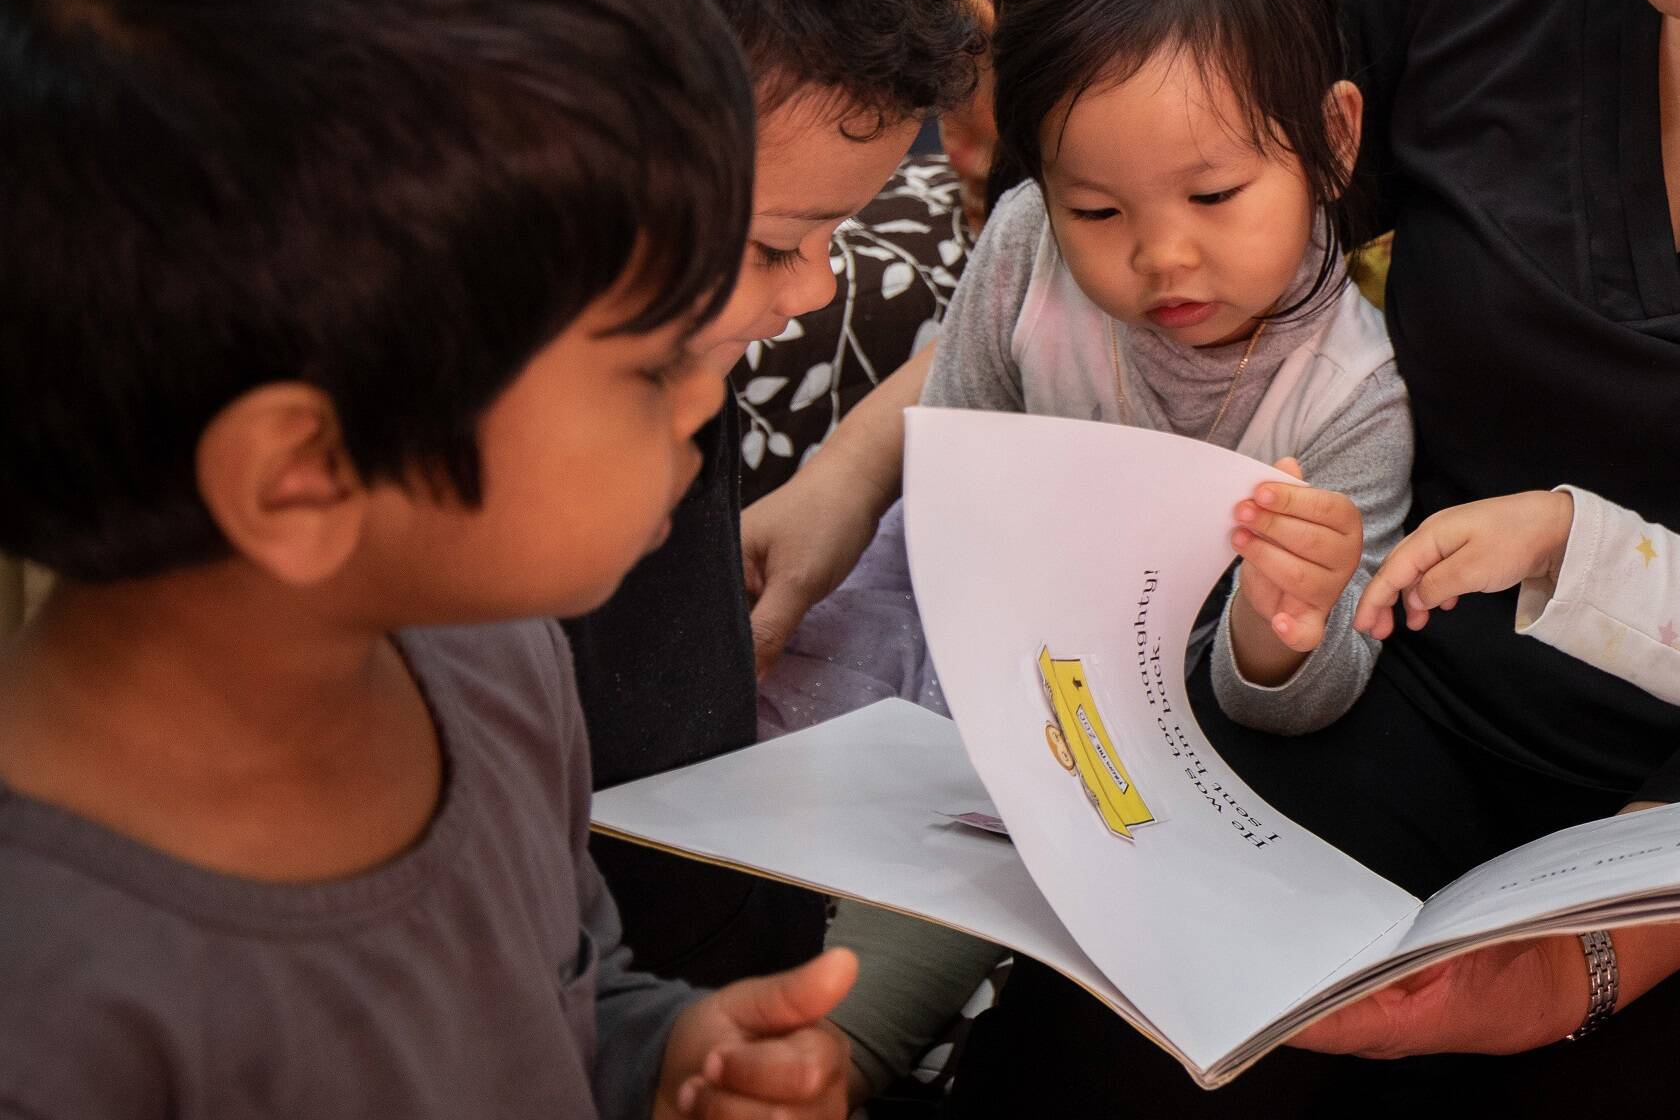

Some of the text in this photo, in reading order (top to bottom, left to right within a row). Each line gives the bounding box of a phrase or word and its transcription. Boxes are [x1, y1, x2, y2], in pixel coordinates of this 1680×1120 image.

[1133, 569, 1270, 850] He was too naughty!
[1149, 635, 1283, 843] I sent him back.
